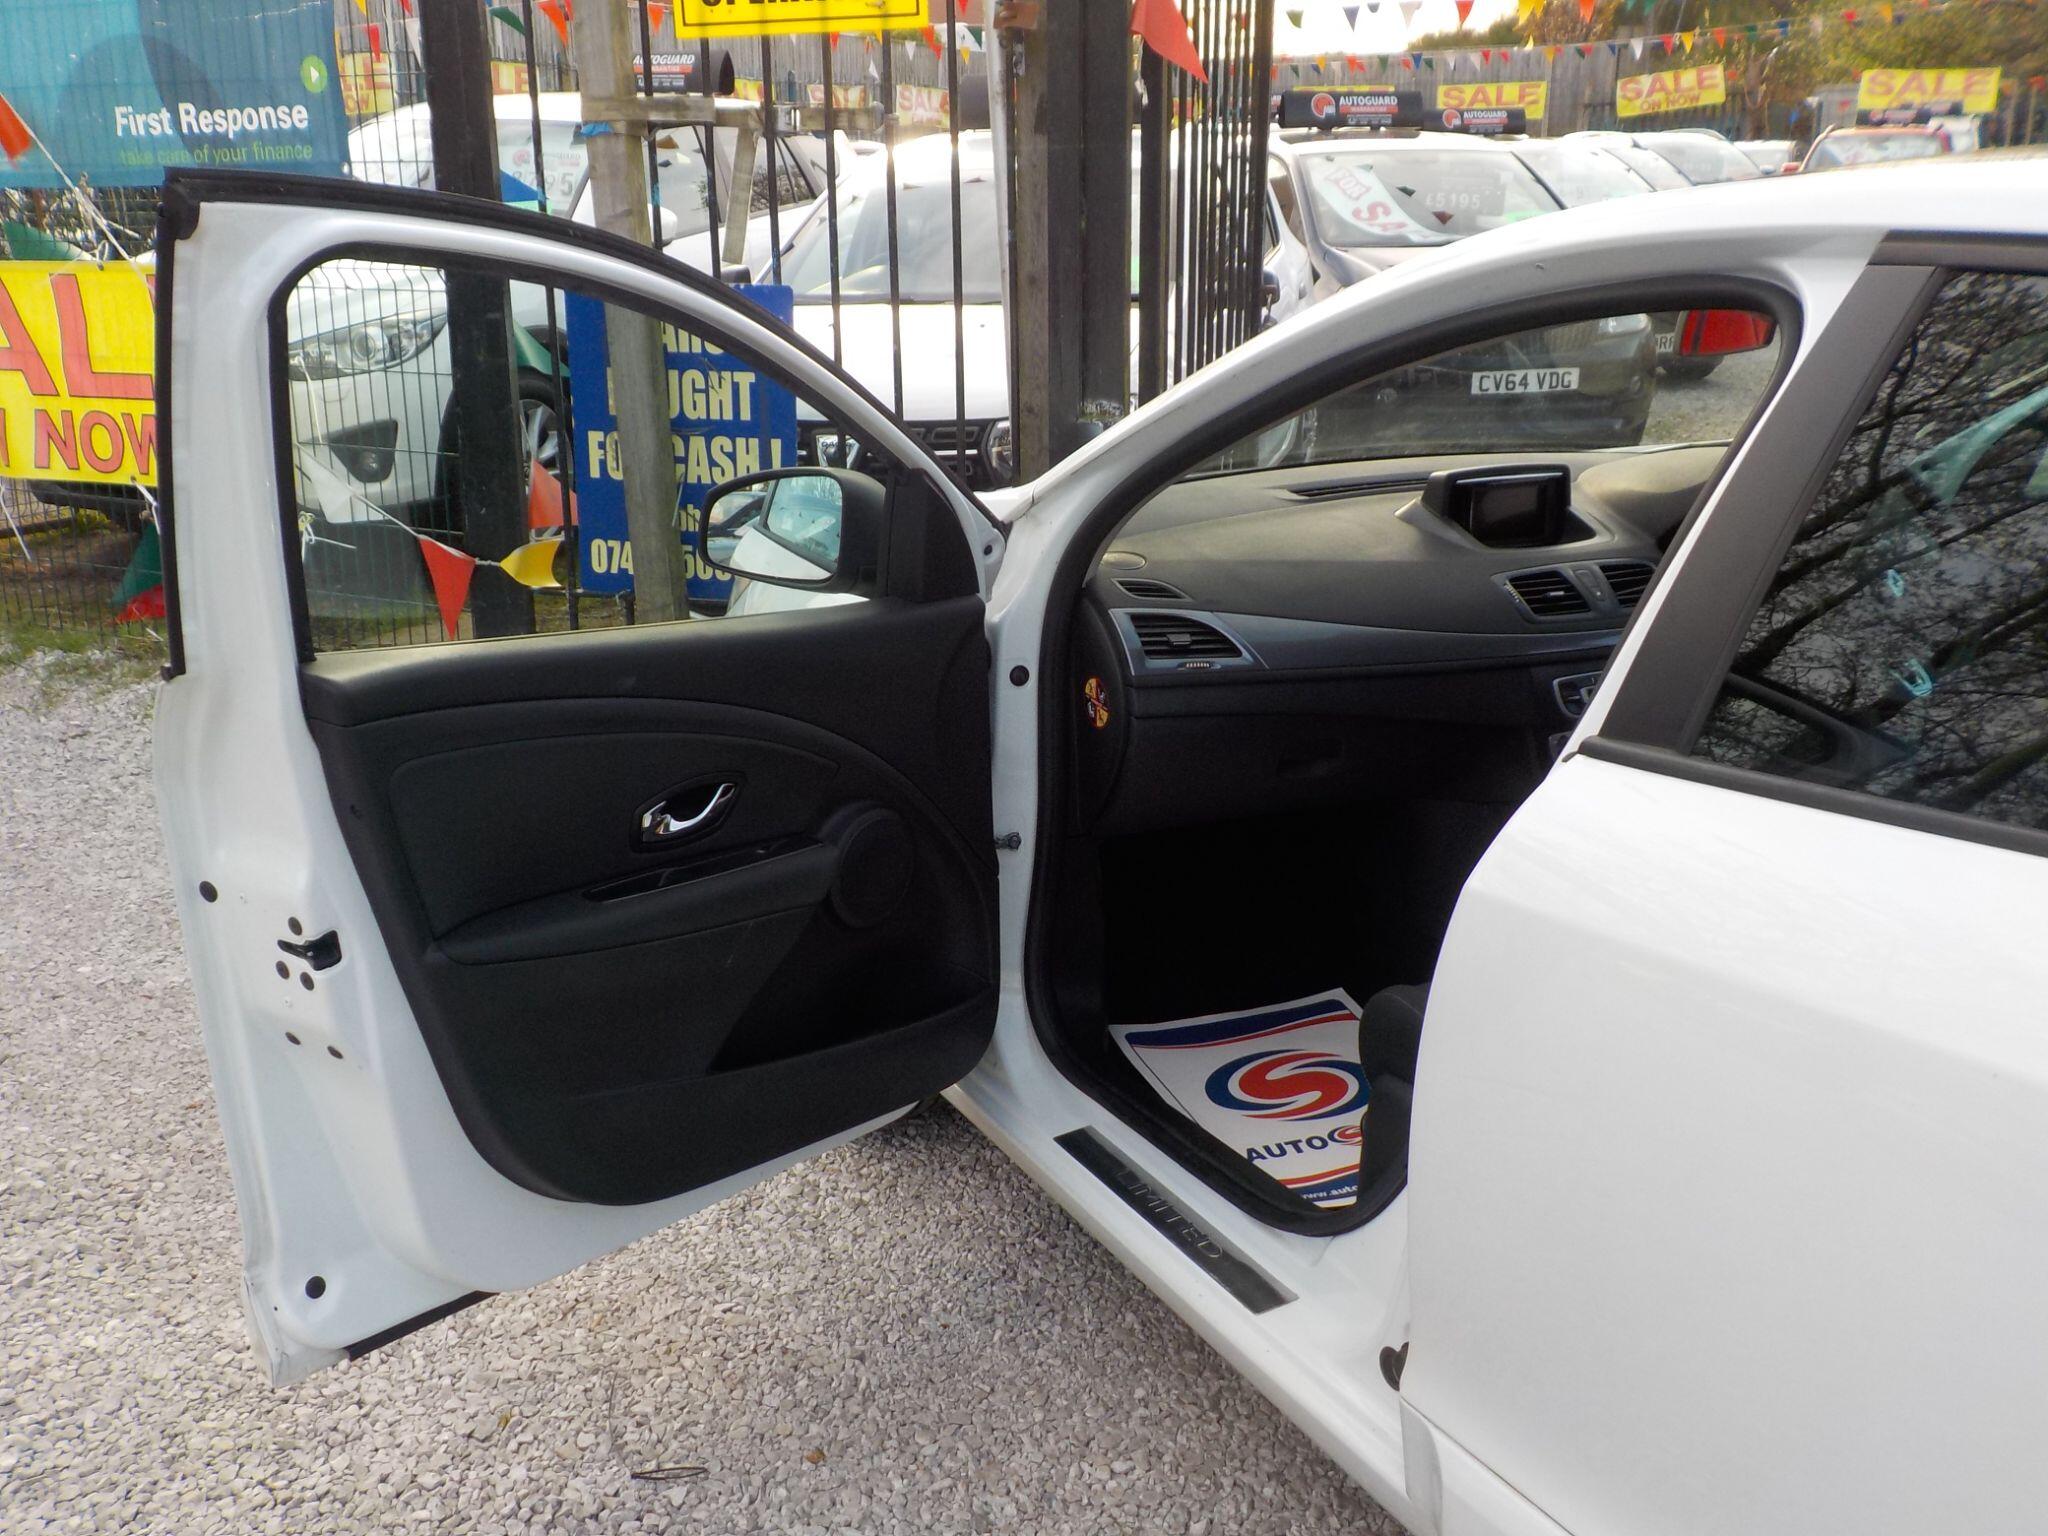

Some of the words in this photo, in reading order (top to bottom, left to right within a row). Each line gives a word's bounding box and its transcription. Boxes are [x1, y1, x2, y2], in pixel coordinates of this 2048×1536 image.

[1620, 64, 1720, 100] SALE
[1868, 69, 1995, 97] SALE
[1339, 96, 1398, 106] AUTOGUARD
[1443, 82, 1541, 109] SALE
[114, 105, 174, 137] First
[178, 102, 309, 138] Response
[1463, 110, 1508, 119] AUTOGUARD
[120, 149, 154, 166] take
[194, 144, 209, 163] of
[212, 147, 248, 168] your
[252, 142, 313, 161] finance
[1478, 373, 1530, 393] CV64
